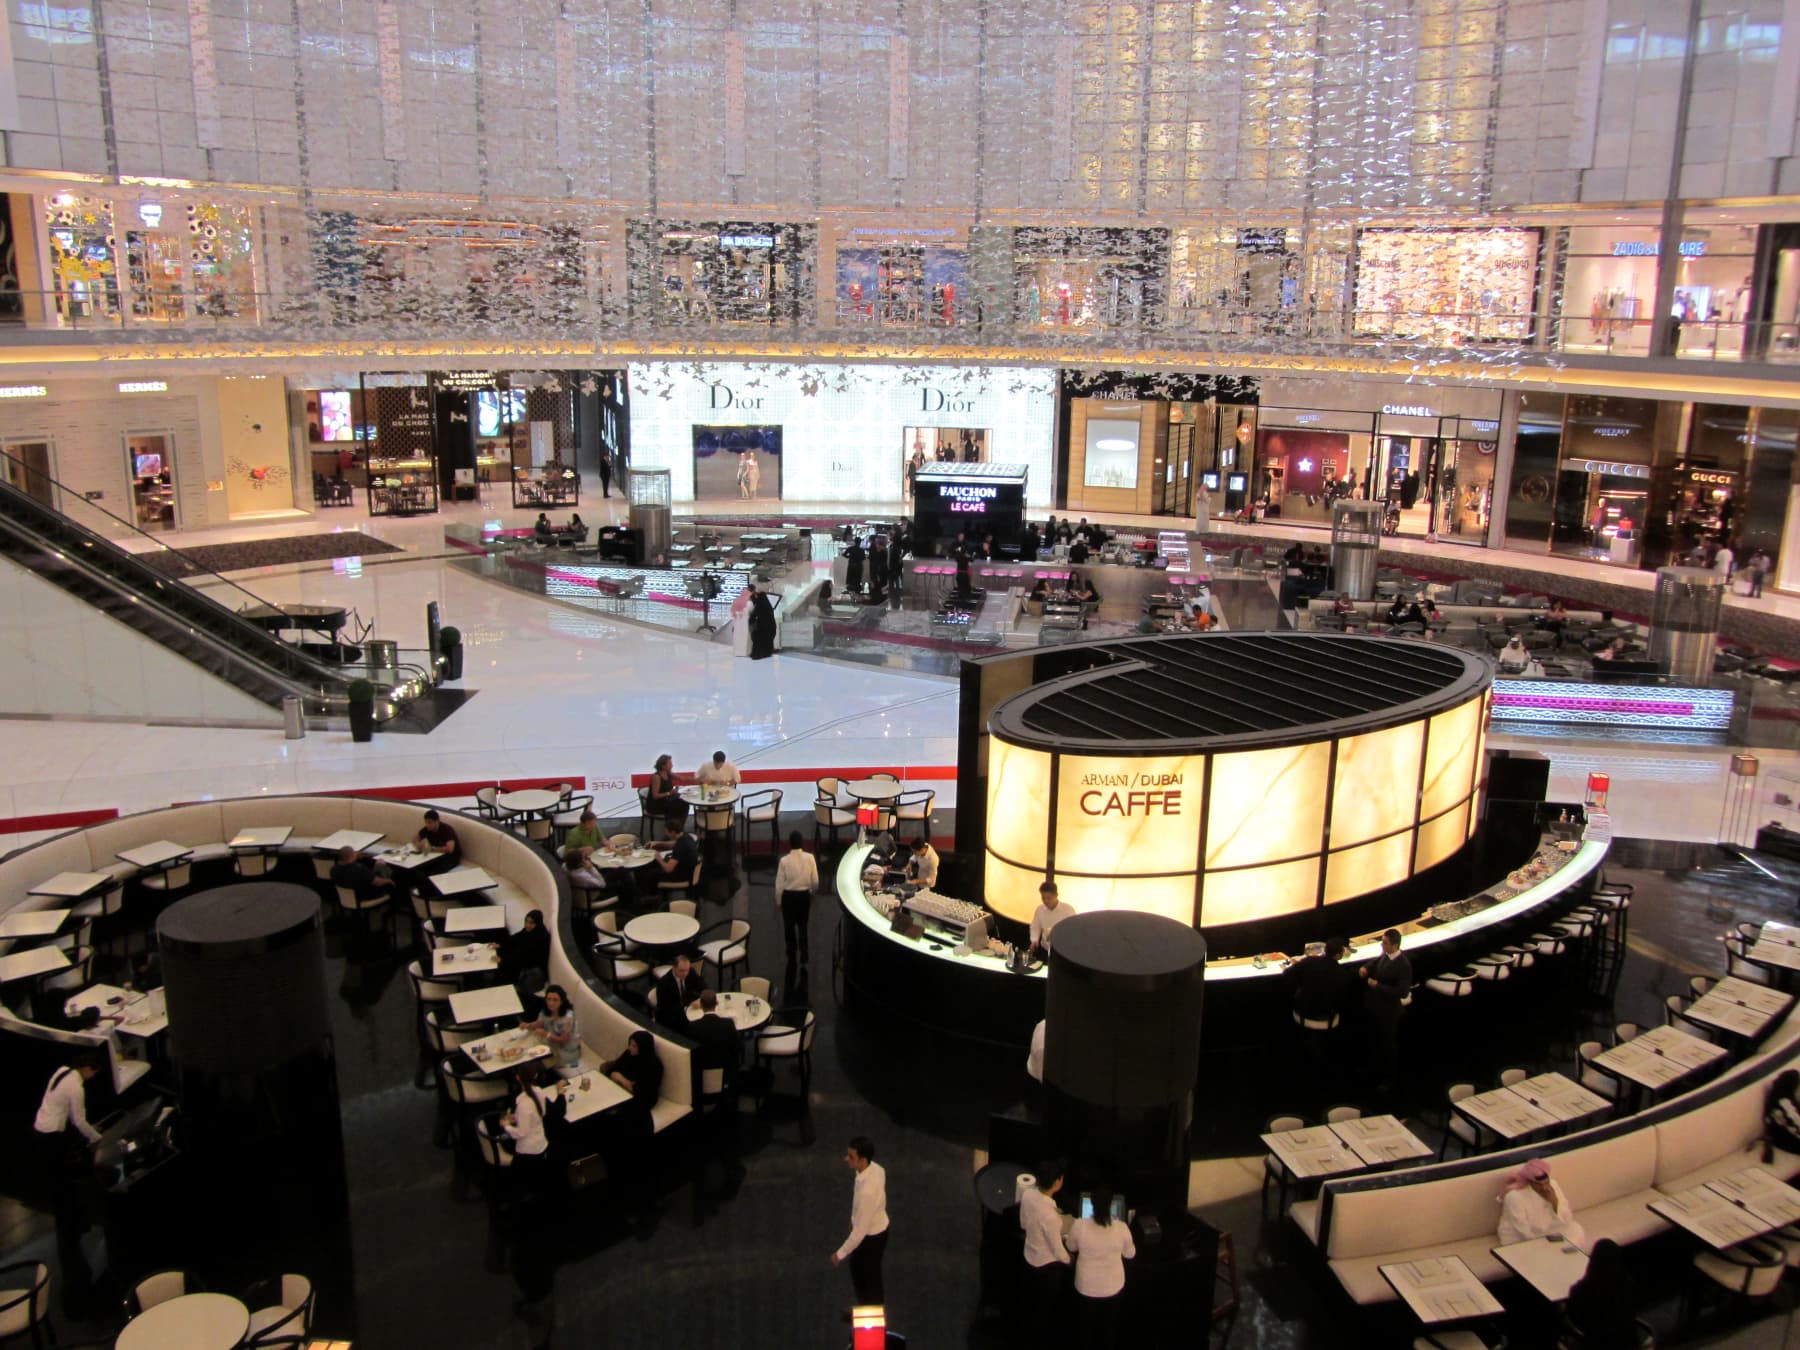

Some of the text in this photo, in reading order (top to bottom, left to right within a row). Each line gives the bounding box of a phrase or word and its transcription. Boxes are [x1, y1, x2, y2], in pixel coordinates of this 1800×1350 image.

[1613, 242, 1644, 256] ZADIG
[709, 384, 765, 409] Dior
[920, 387, 976, 412] Dior
[1382, 404, 1432, 417] CHANEL
[1584, 461, 1641, 478] GUCCI
[1691, 472, 1731, 484] GUCCI
[939, 485, 998, 498] FAUCHON
[950, 501, 986, 512] LE CAFÉ
[1080, 789, 1182, 817] CAFFE
